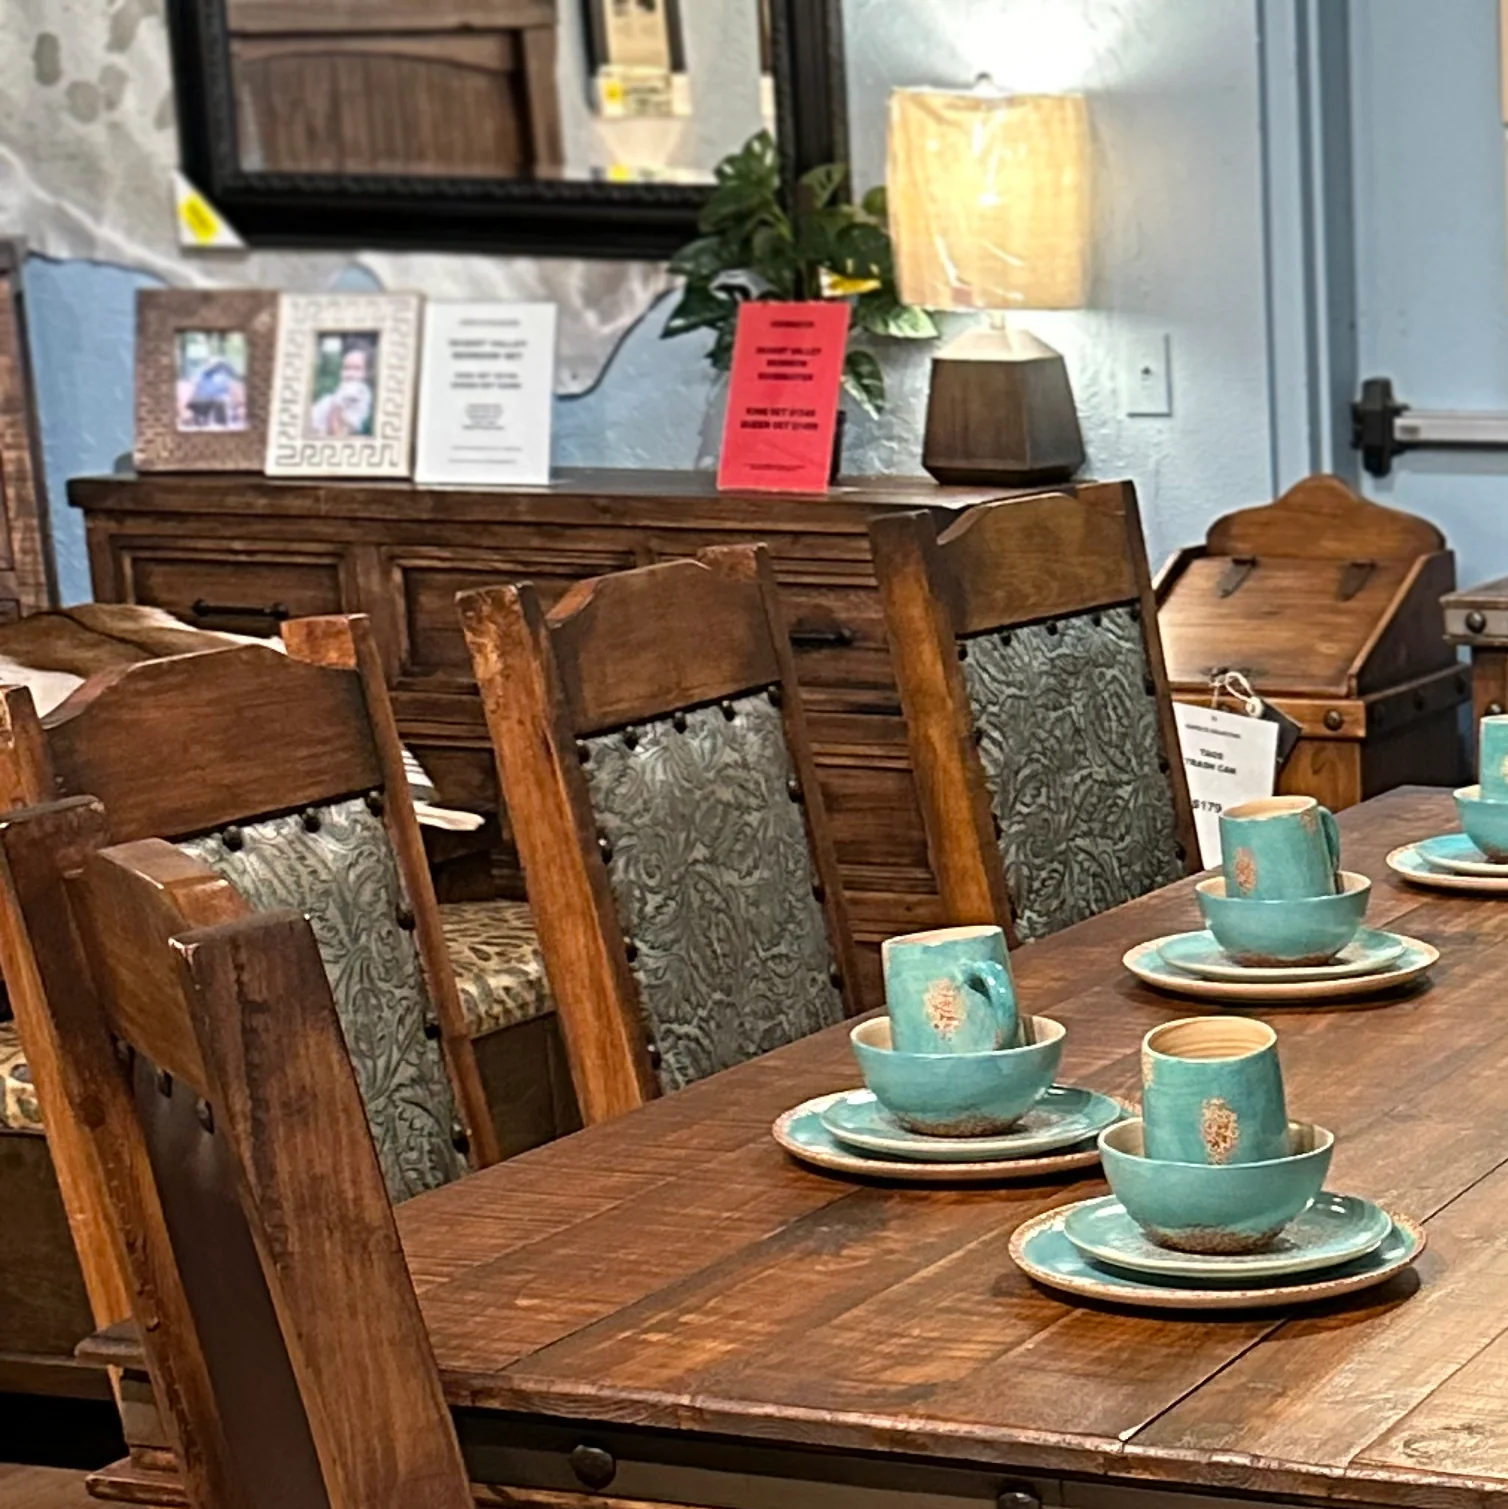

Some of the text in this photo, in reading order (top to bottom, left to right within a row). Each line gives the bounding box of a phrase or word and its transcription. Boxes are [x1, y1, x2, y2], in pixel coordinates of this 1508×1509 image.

[1185, 757, 1237, 775] TRASH CAN
[1191, 799, 1223, 814] $179
